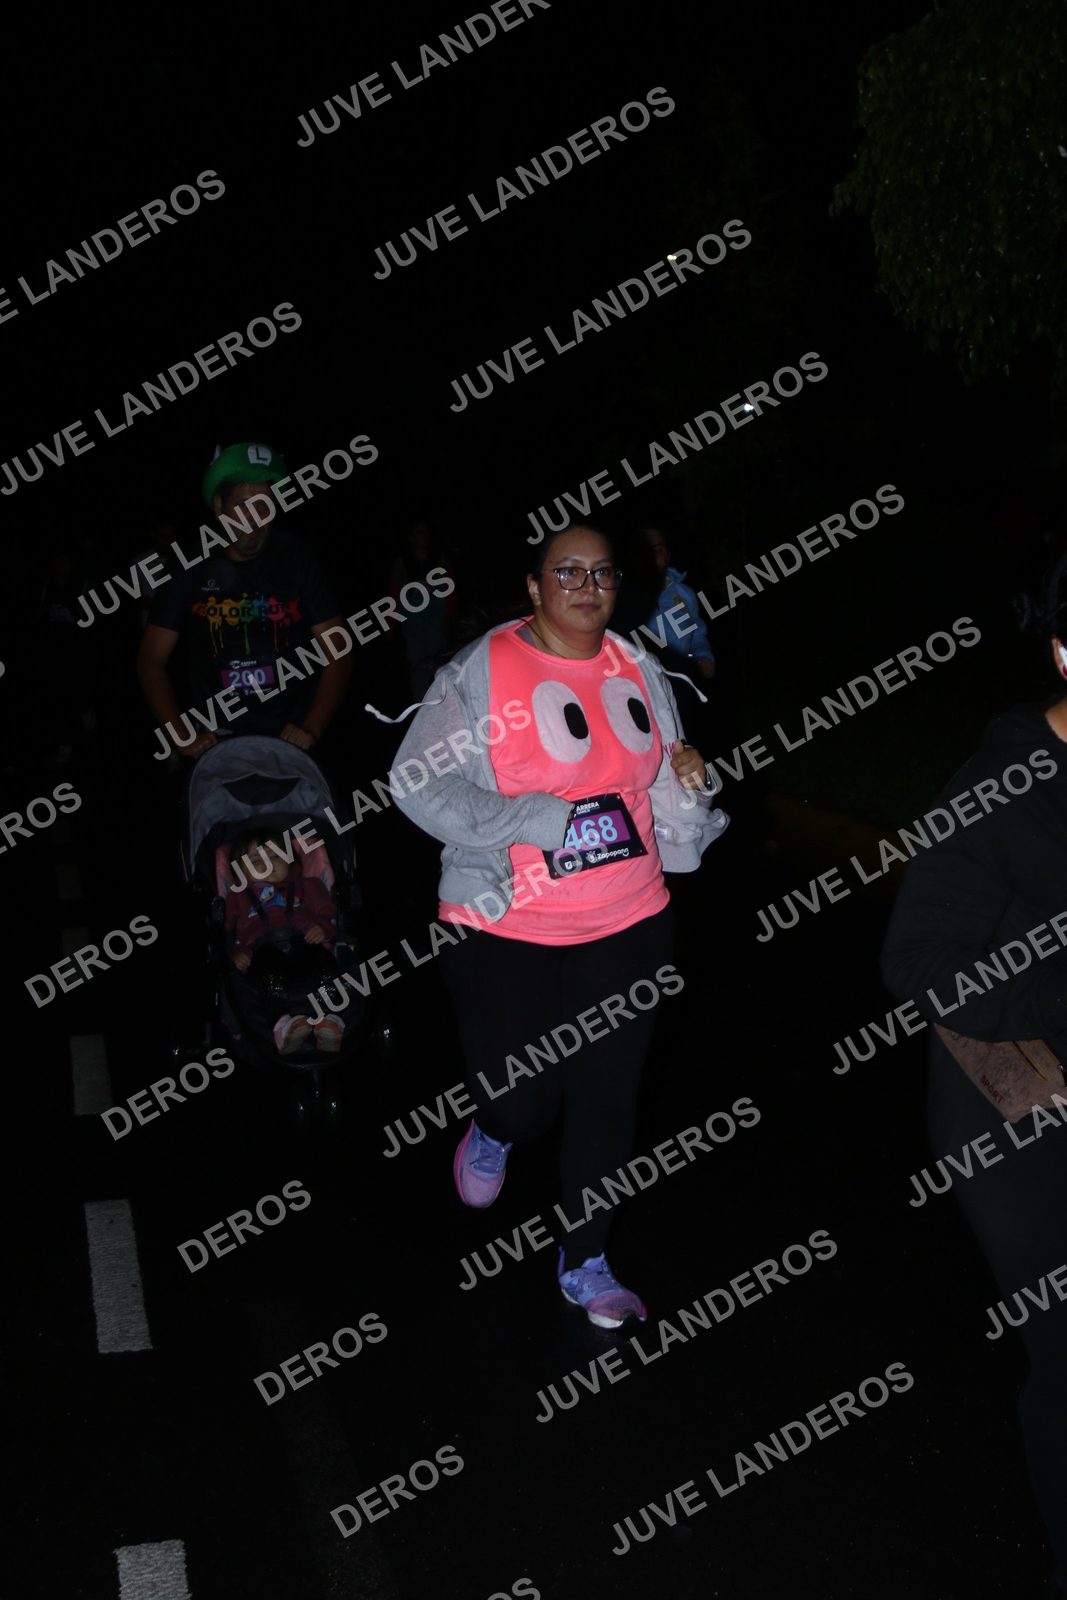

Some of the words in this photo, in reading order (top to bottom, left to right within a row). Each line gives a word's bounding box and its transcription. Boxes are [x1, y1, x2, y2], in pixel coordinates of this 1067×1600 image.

[228, 669, 266, 688] 200
[564, 815, 618, 850] 468
[981, 1075, 1004, 1104] SPORT
